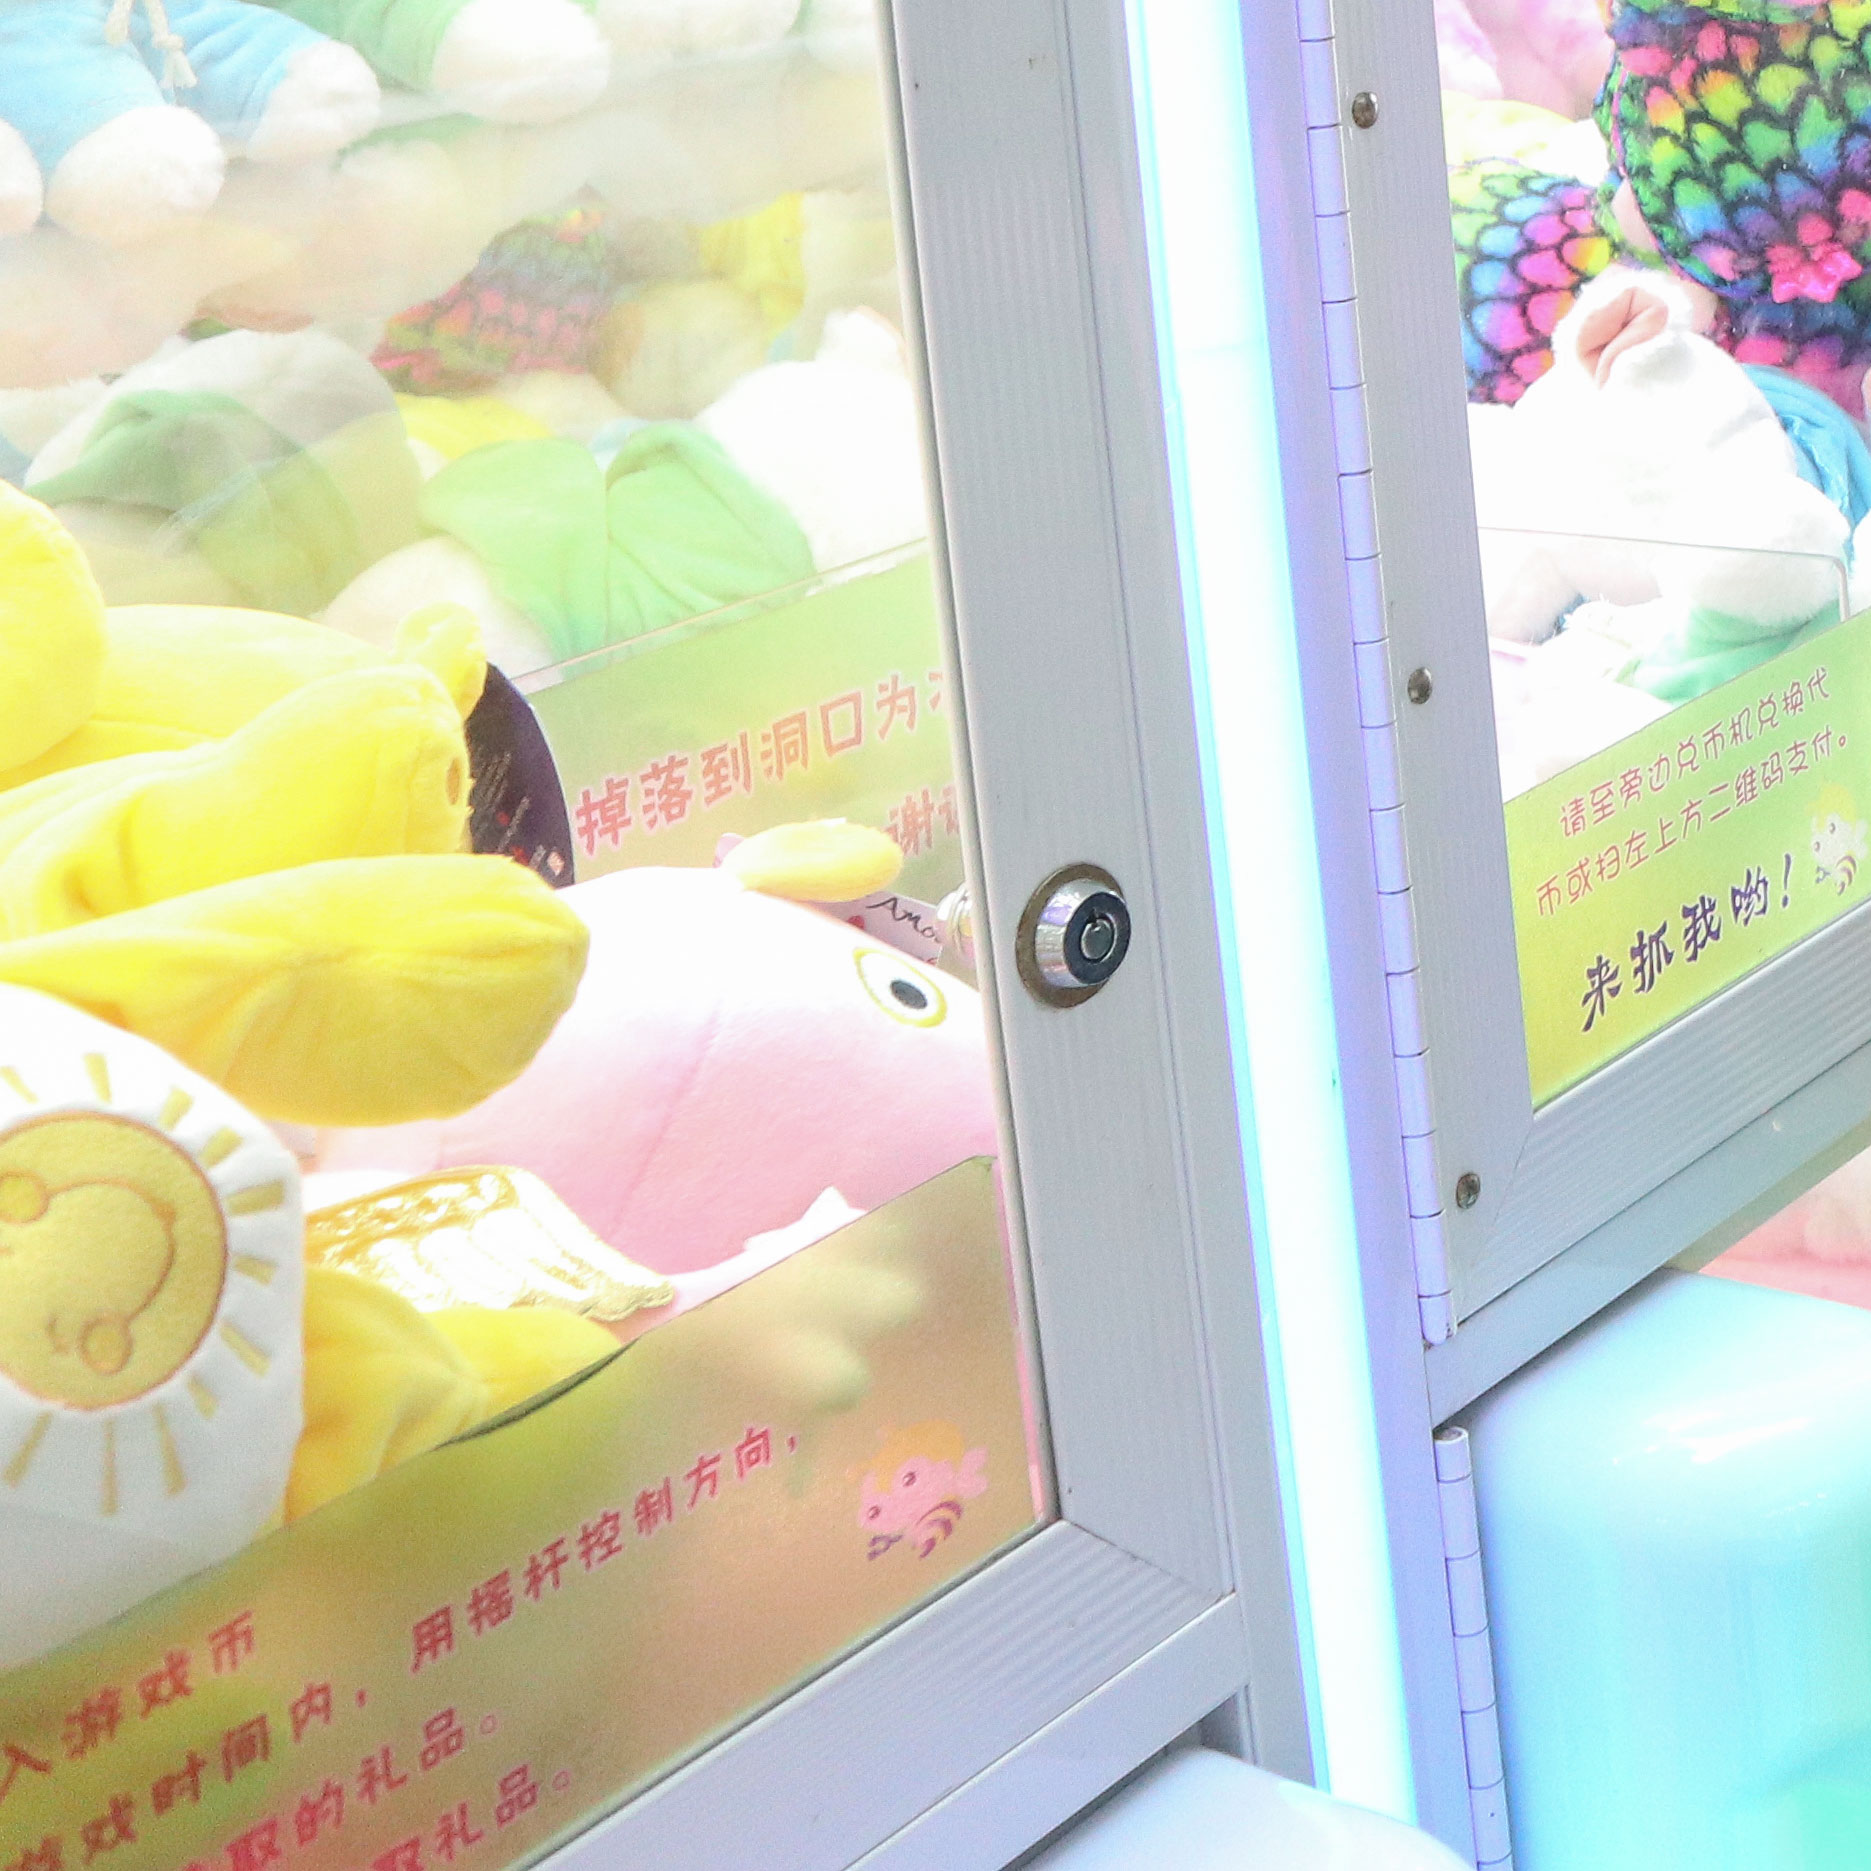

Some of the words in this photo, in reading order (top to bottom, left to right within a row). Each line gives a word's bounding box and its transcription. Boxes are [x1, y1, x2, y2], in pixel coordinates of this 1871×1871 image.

[1536, 725, 1848, 917] 币或扫左上方二维码支付。
[1559, 666, 1831, 838] 请至旁边兑币机兑换代
